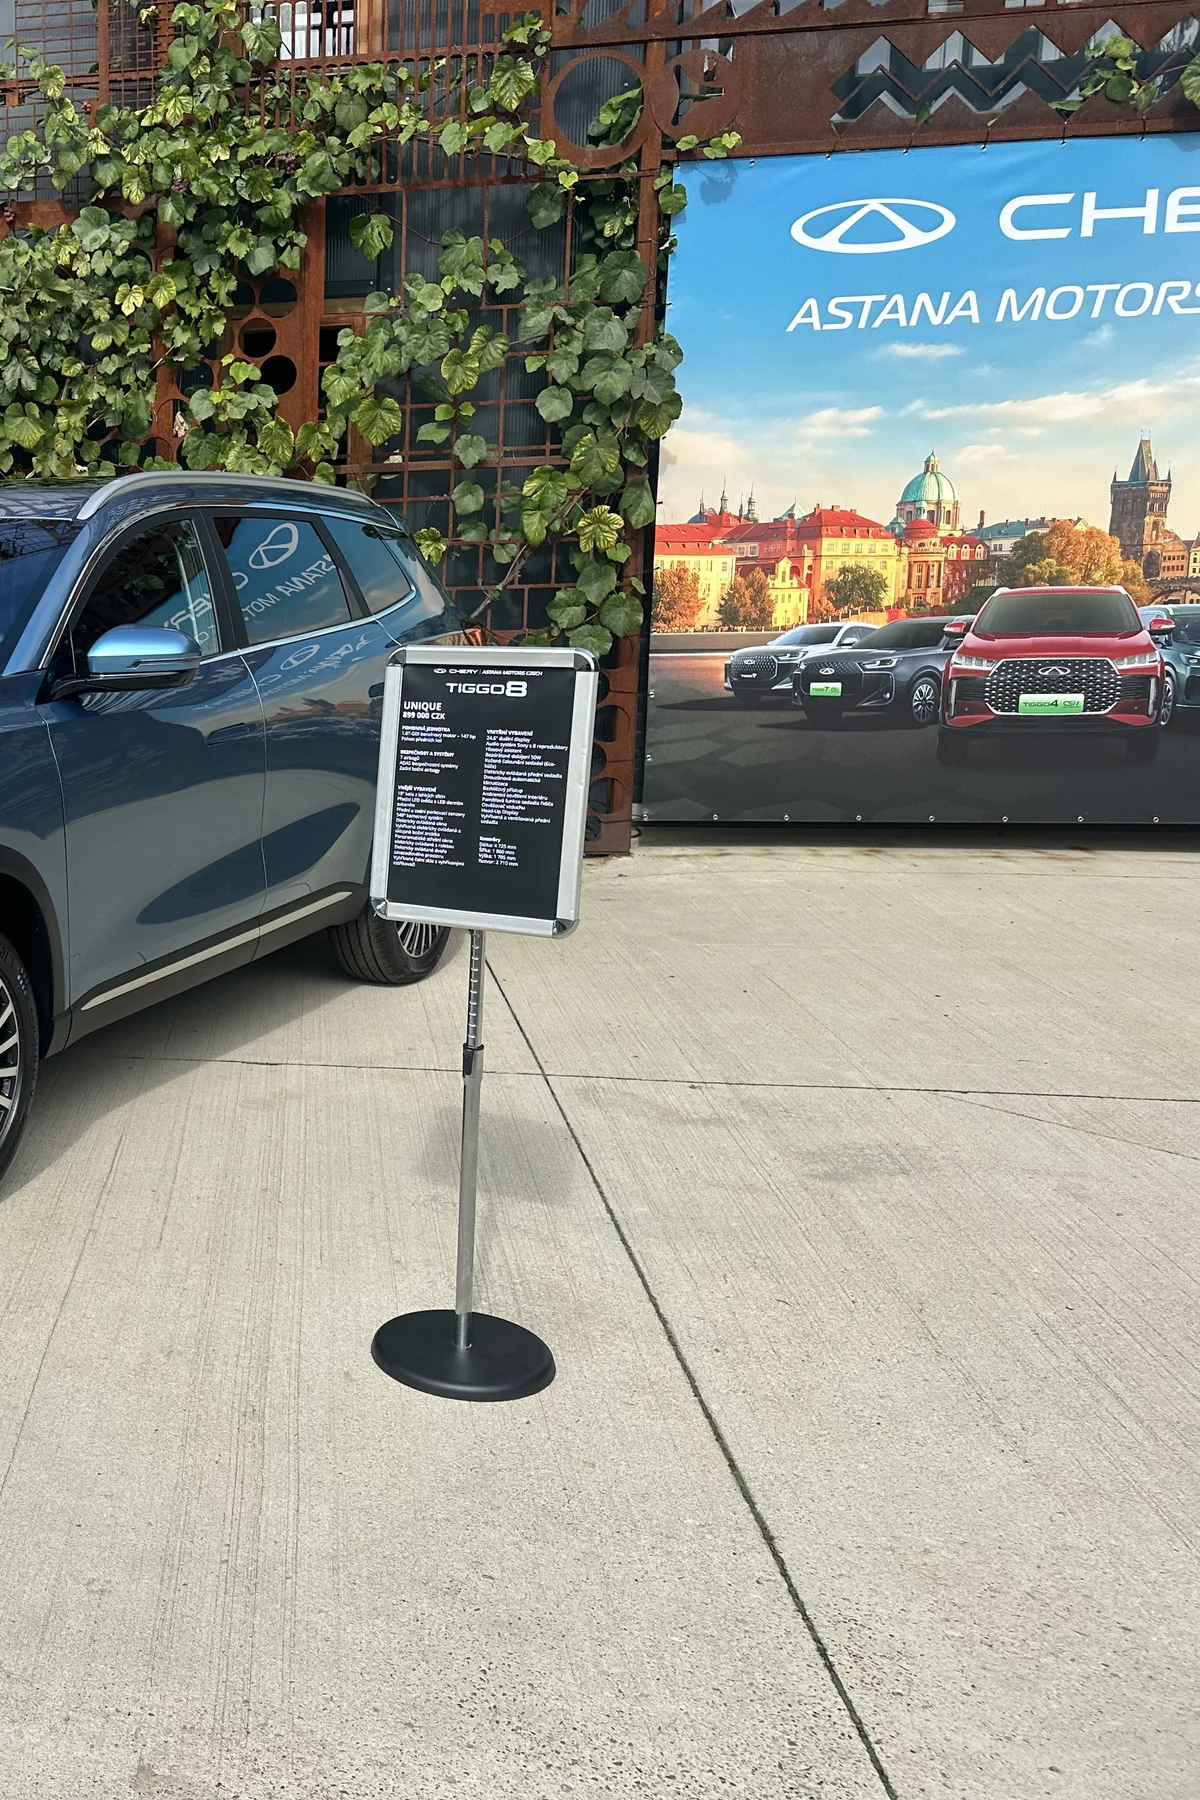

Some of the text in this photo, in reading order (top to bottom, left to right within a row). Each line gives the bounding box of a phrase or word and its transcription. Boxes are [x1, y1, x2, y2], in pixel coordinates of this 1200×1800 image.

[786, 281, 1200, 332] ASTANA MOTOR
[446, 681, 527, 697] TIGGO8
[404, 701, 442, 712] UNIQUE
